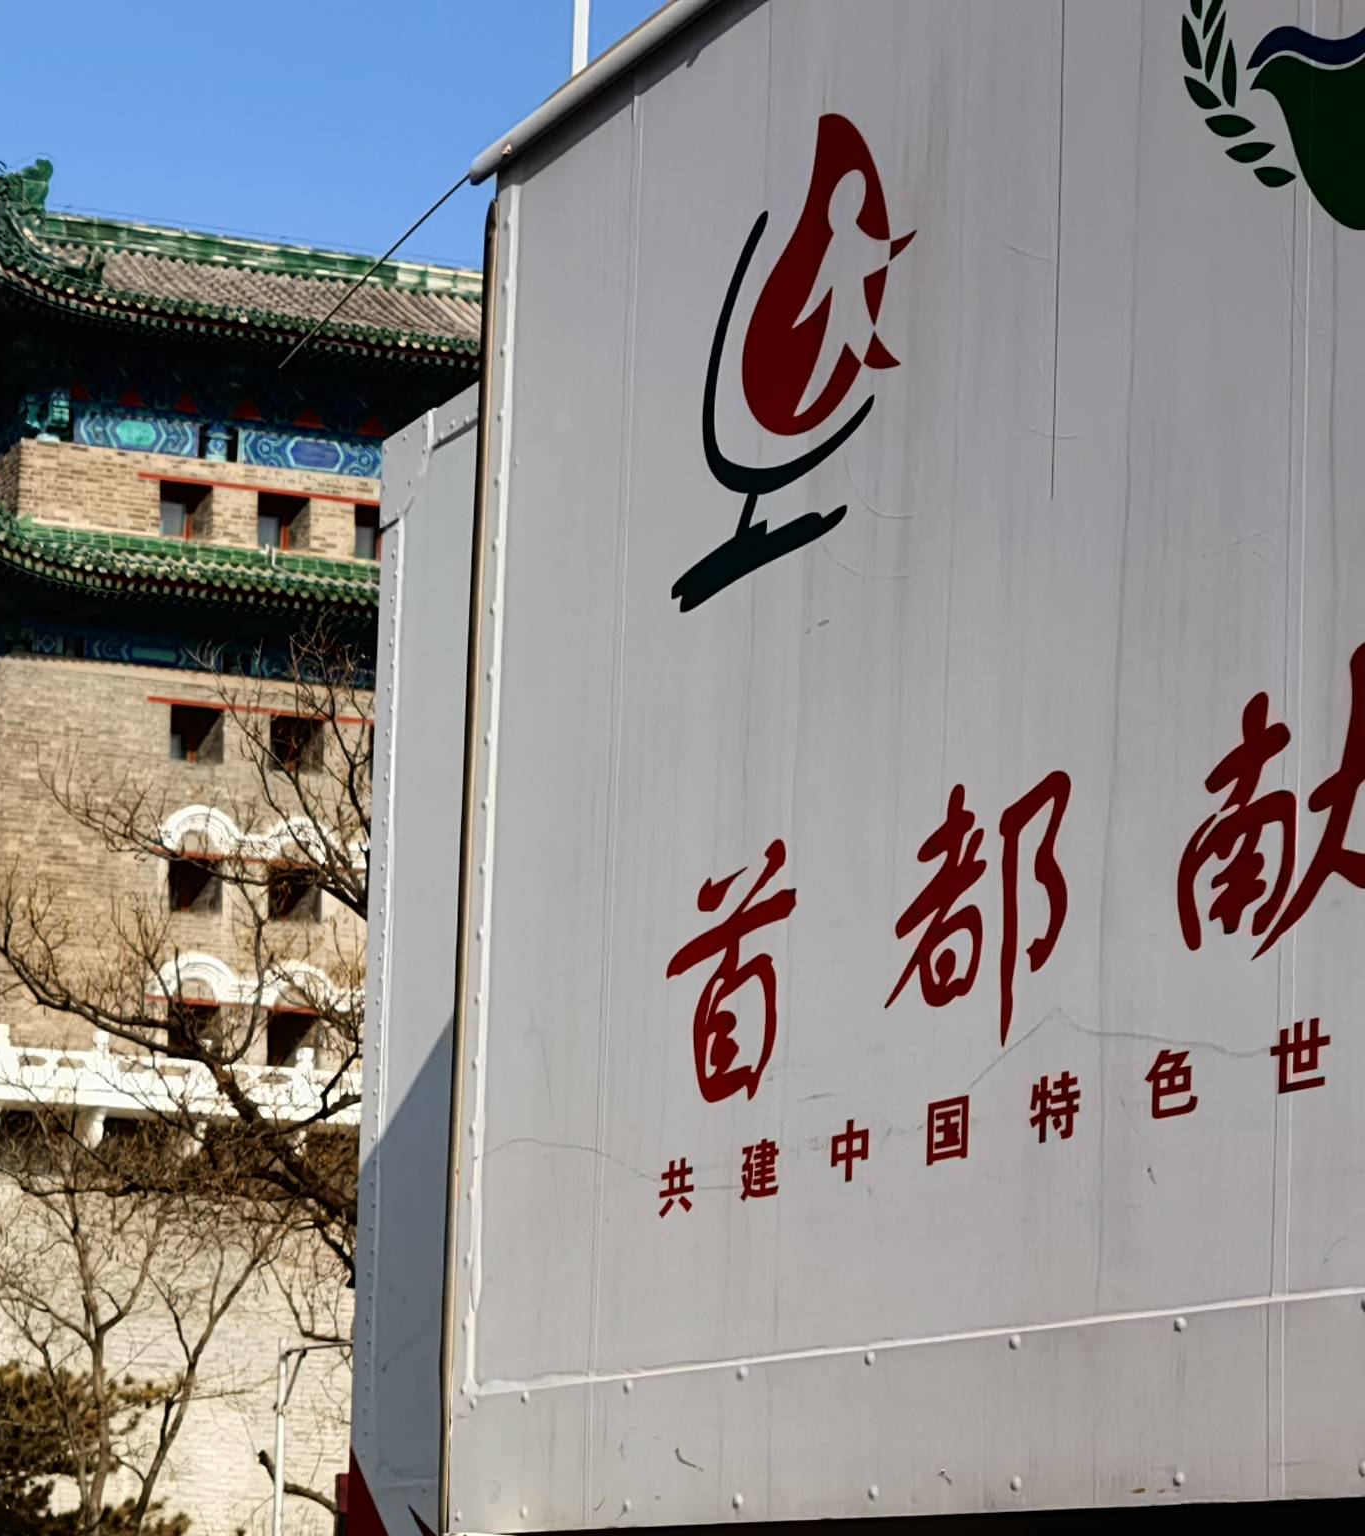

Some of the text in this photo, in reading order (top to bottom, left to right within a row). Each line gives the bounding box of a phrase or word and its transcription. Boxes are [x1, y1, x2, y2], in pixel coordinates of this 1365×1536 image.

[658, 1018, 1330, 1218] 共建中国特色世
